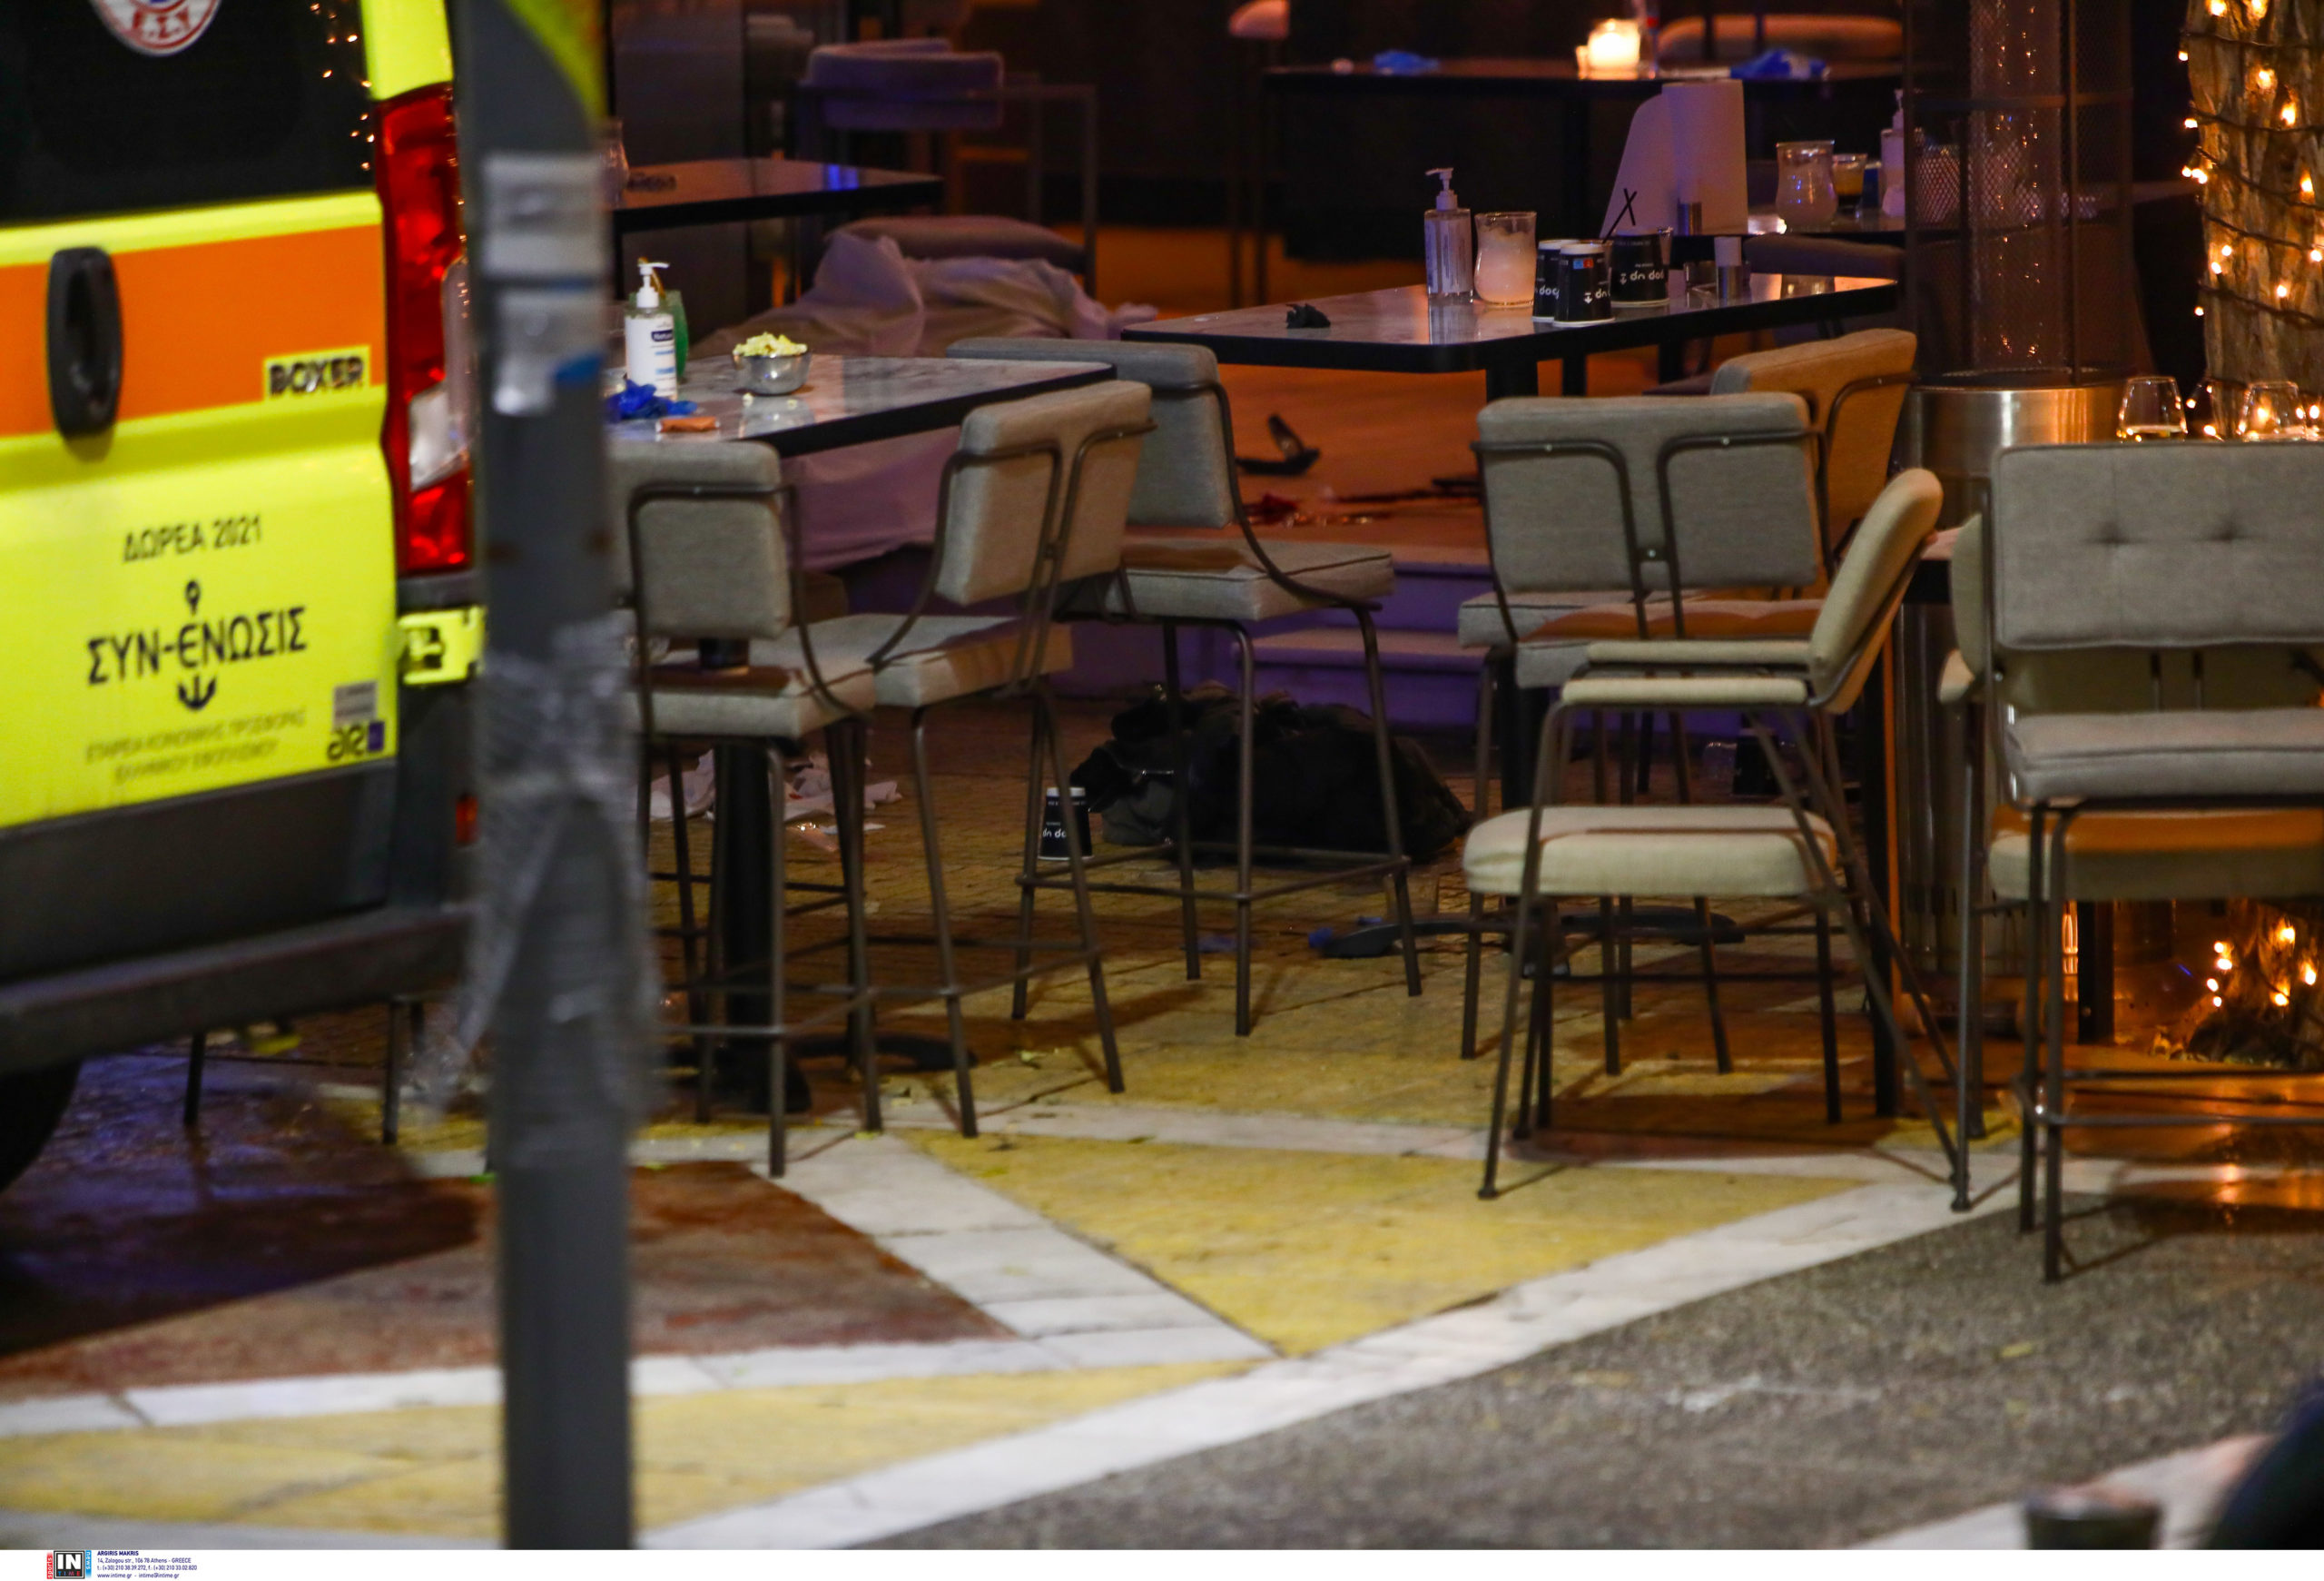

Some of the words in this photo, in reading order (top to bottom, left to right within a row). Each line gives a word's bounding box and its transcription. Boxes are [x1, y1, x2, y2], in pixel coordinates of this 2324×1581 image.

[271, 357, 363, 396] BOXER
[123, 523, 205, 563] ΔΩΡΕΑ
[213, 514, 261, 549] 2021
